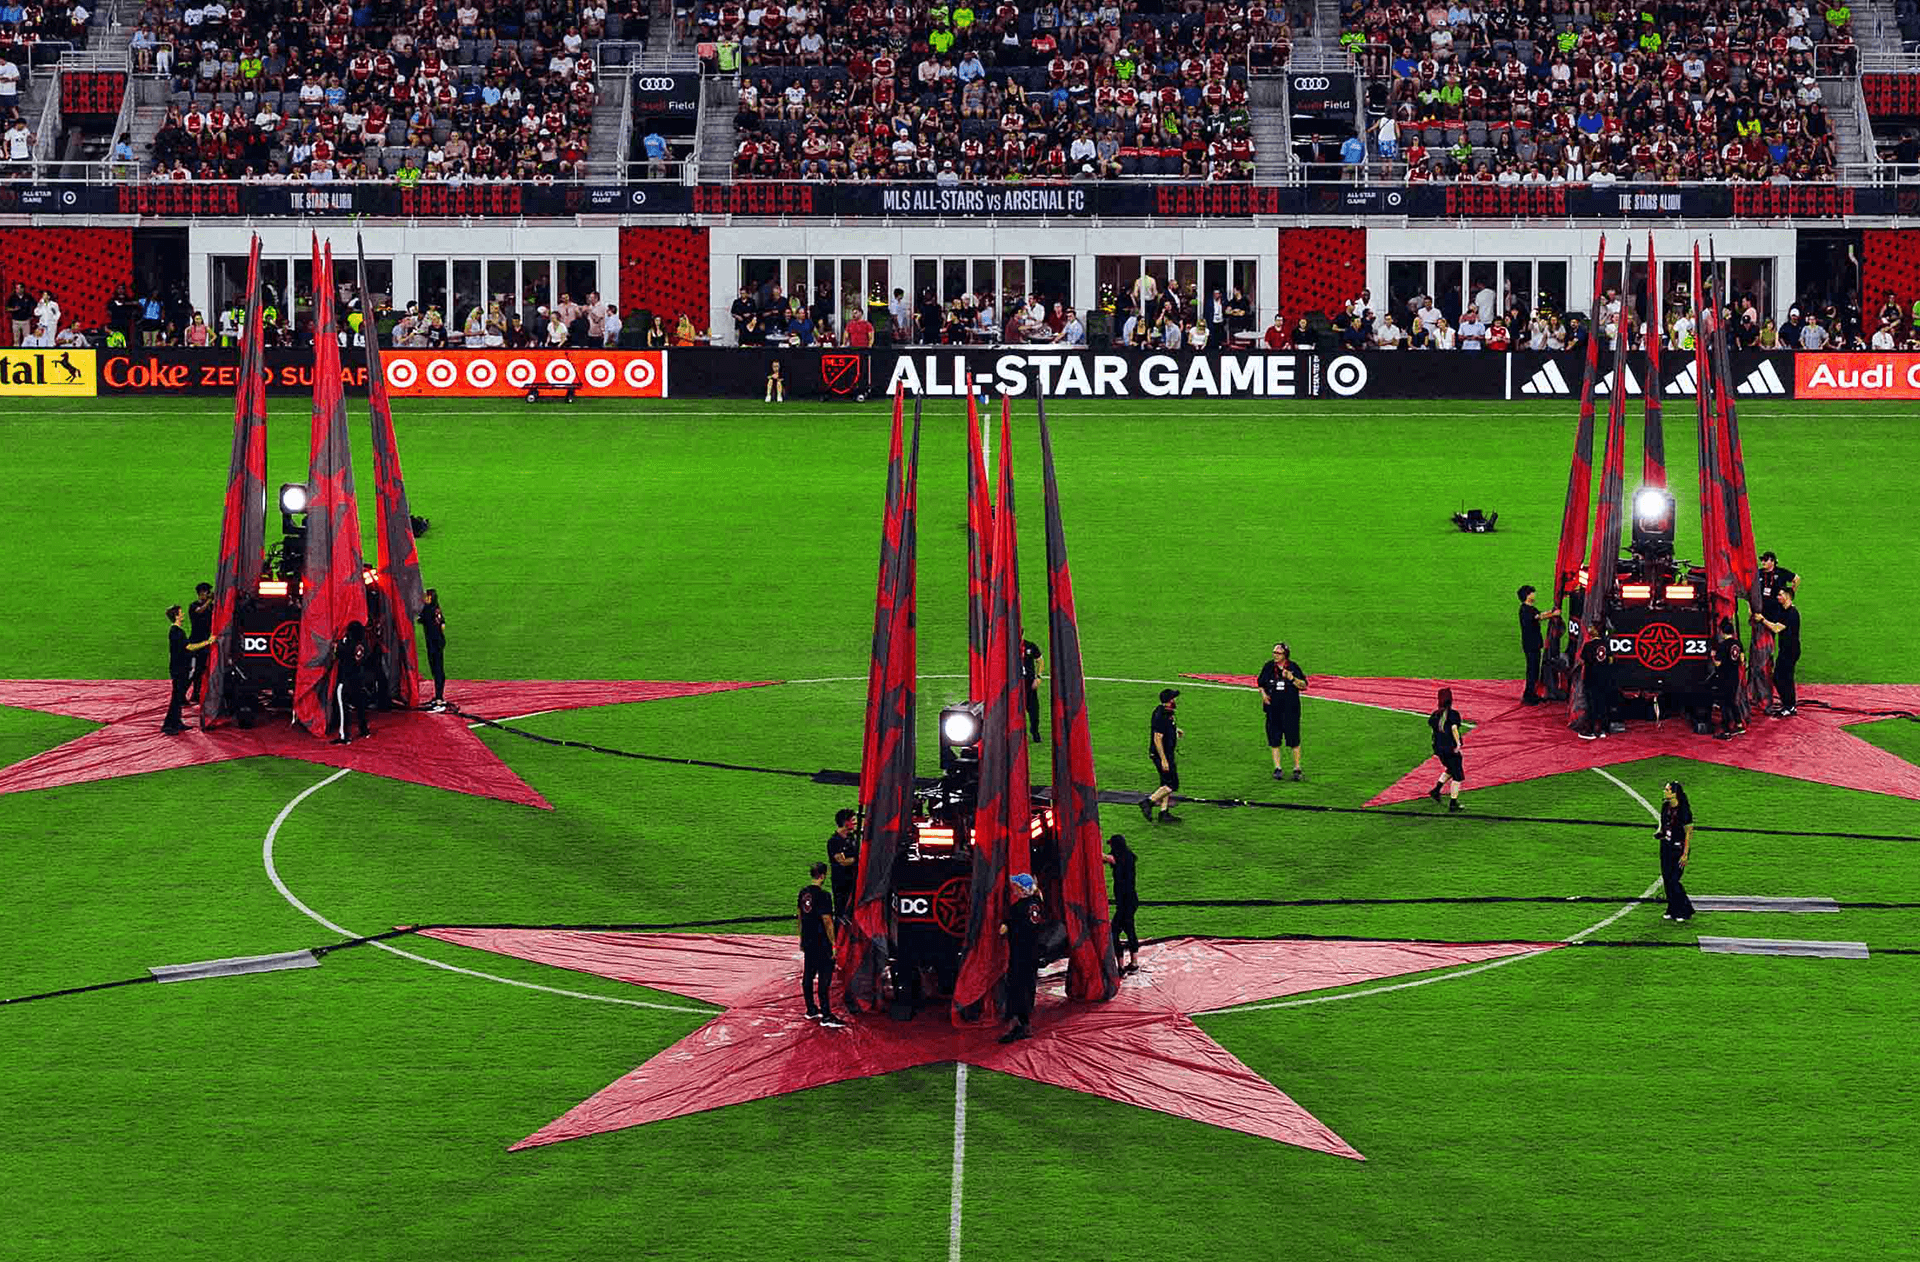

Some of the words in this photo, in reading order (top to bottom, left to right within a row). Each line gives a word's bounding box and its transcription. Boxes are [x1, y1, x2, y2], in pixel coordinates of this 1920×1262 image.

[669, 101, 695, 111] Field
[1324, 100, 1350, 109] Field
[290, 192, 304, 209] THE
[884, 190, 910, 211] MLS
[913, 190, 984, 211] ALL-STARS
[1004, 190, 1065, 211] ARSENAL
[1068, 190, 1085, 211] FC
[1618, 193, 1632, 210] THE
[0, 354, 48, 385] tal
[104, 356, 192, 387] Coke
[281, 366, 370, 386] SUAR
[886, 355, 1129, 396] ALL-STAR
[1139, 355, 1296, 396] GAME
[1808, 363, 1893, 388] Audi
[244, 637, 267, 651] DC
[1610, 639, 1632, 652] DC
[1685, 640, 1707, 653] 23
[900, 898, 928, 914] DC
